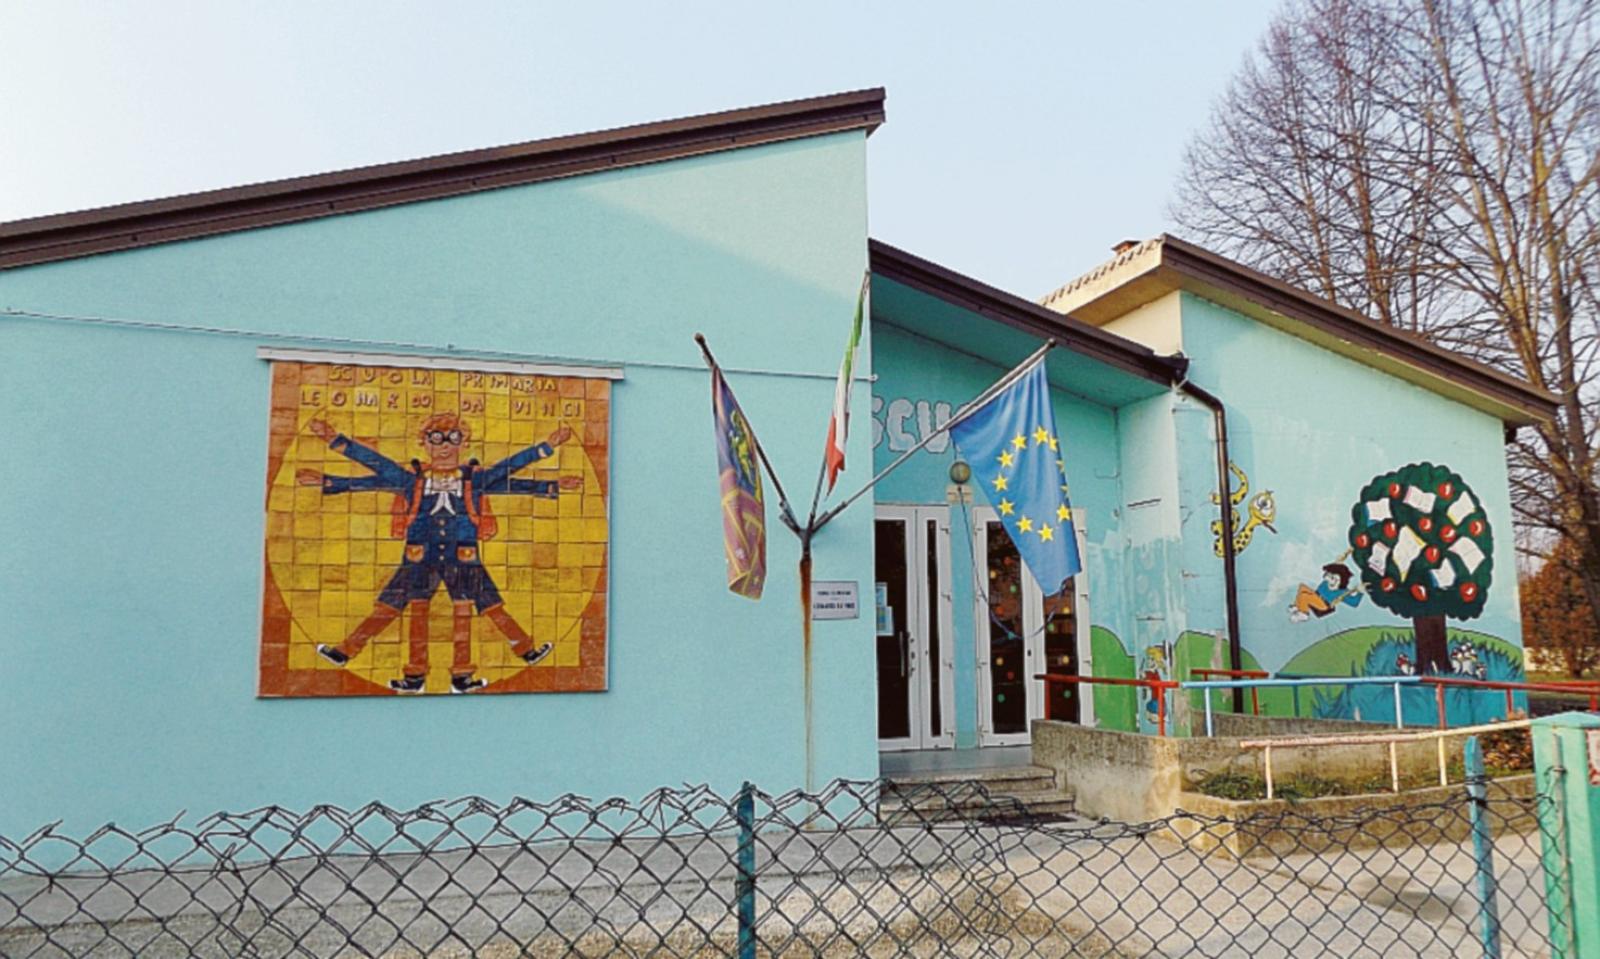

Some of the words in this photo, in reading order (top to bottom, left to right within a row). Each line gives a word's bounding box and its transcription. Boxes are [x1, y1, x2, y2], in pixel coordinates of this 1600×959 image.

[329, 364, 432, 385] SCUOLA
[462, 373, 557, 393] PRIMARIA
[301, 390, 432, 409] LEONARDO
[462, 400, 484, 413] DA
[515, 402, 581, 416] VINCI
